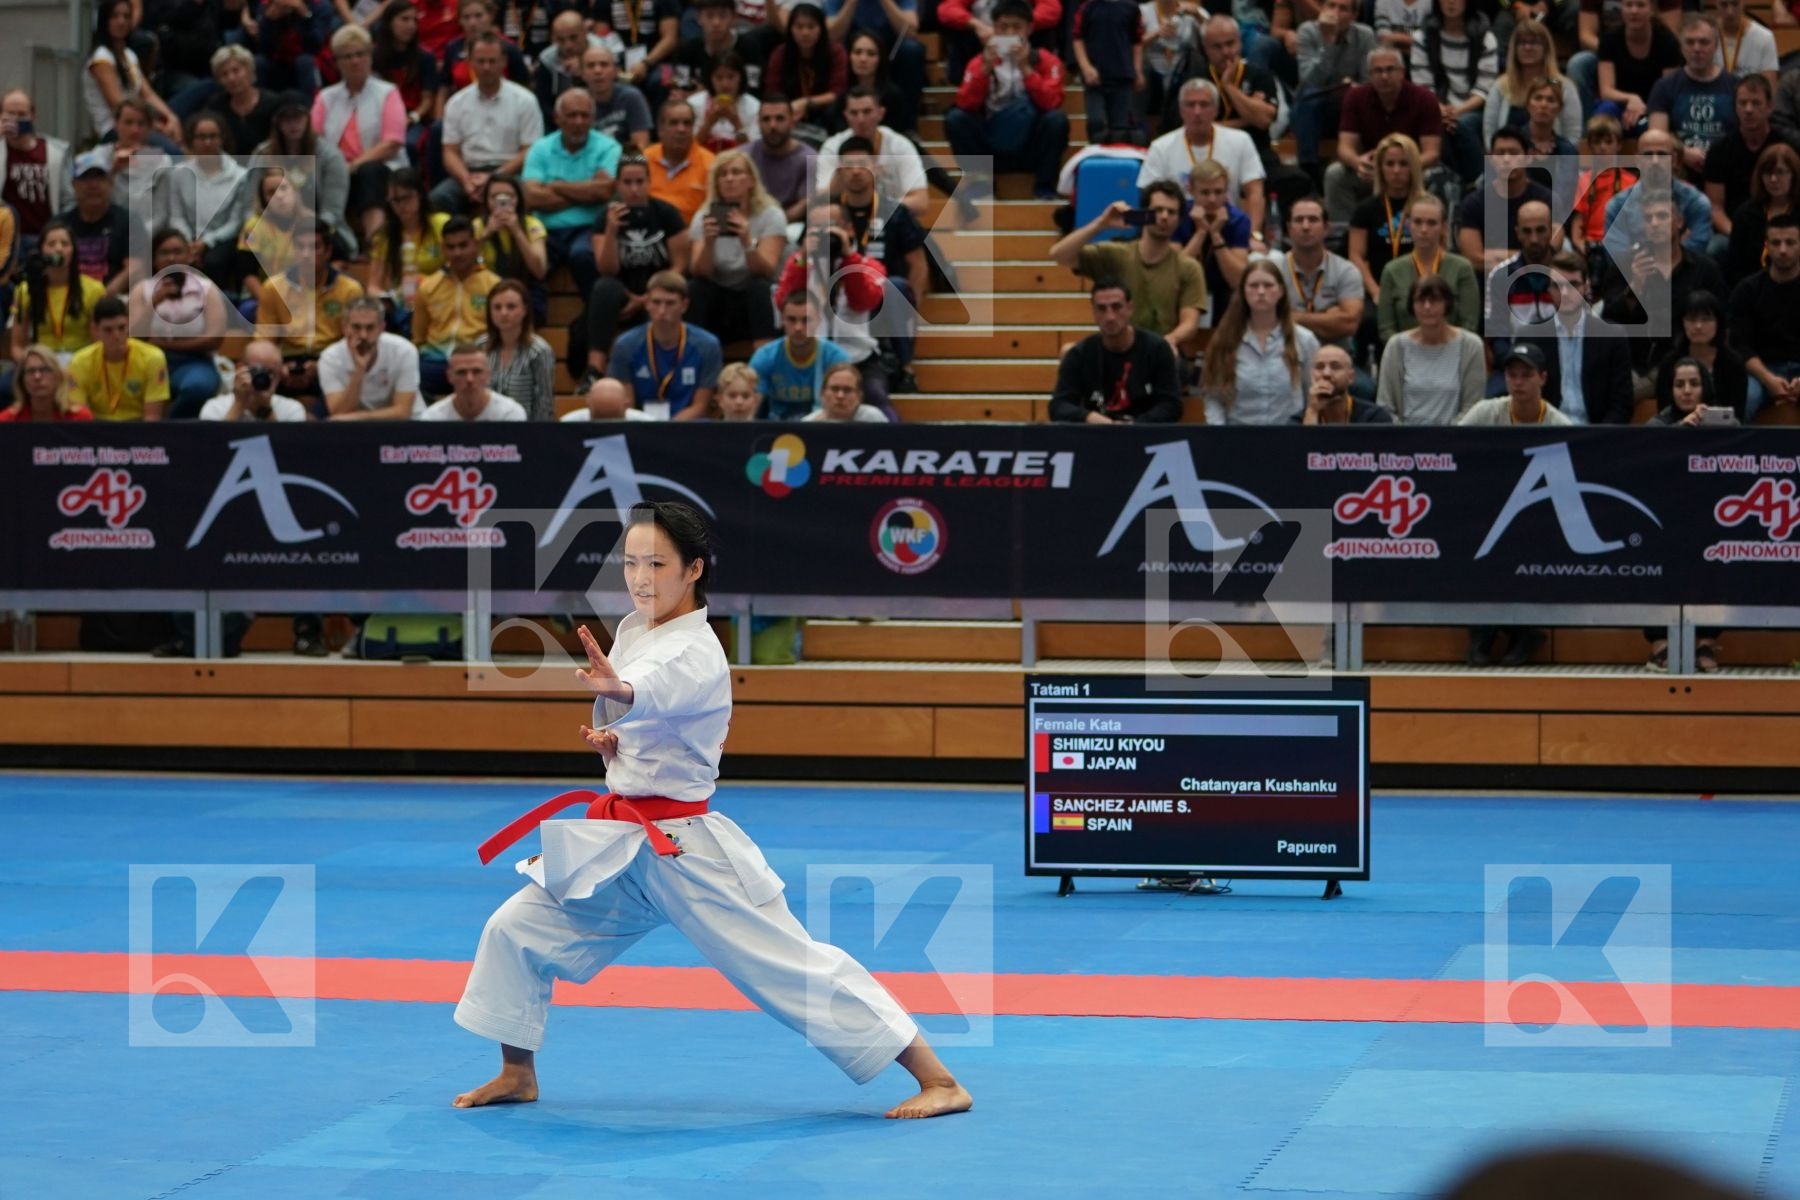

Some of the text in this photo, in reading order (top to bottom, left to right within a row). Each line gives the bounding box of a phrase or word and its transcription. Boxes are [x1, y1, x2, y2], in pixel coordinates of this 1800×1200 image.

[1308, 453, 1456, 472] Eat Well, Live Well.
[1688, 455, 1716, 472] Eat
[1718, 455, 1759, 474] Well,
[1760, 455, 1796, 473] Live
[819, 474, 1049, 488] PREMIER LEAGUE
[49, 529, 155, 550] AJINOMOTO
[396, 528, 506, 550] AJINOMOTO
[889, 527, 926, 544] WKF
[1323, 538, 1440, 560] AJINOMOTO
[1703, 541, 1800, 562] AJINOMOT
[224, 552, 359, 564] ARAWAZA.COM
[1137, 561, 1283, 573] ARAWAZA.COM
[1516, 564, 1662, 576] ARAWAZA.COM
[1031, 683, 1090, 696] Tatami 1
[1035, 718, 1121, 731] Female Kata
[1053, 738, 1165, 751] SHIMIZU KIYOU
[1087, 757, 1136, 770] JAPAN
[1180, 778, 1337, 794] Chatanyara Kushanku
[1053, 798, 1191, 813] SANCHEZ JAIME S.
[1087, 818, 1132, 831] SPAIN
[1277, 840, 1337, 856] Papuren
